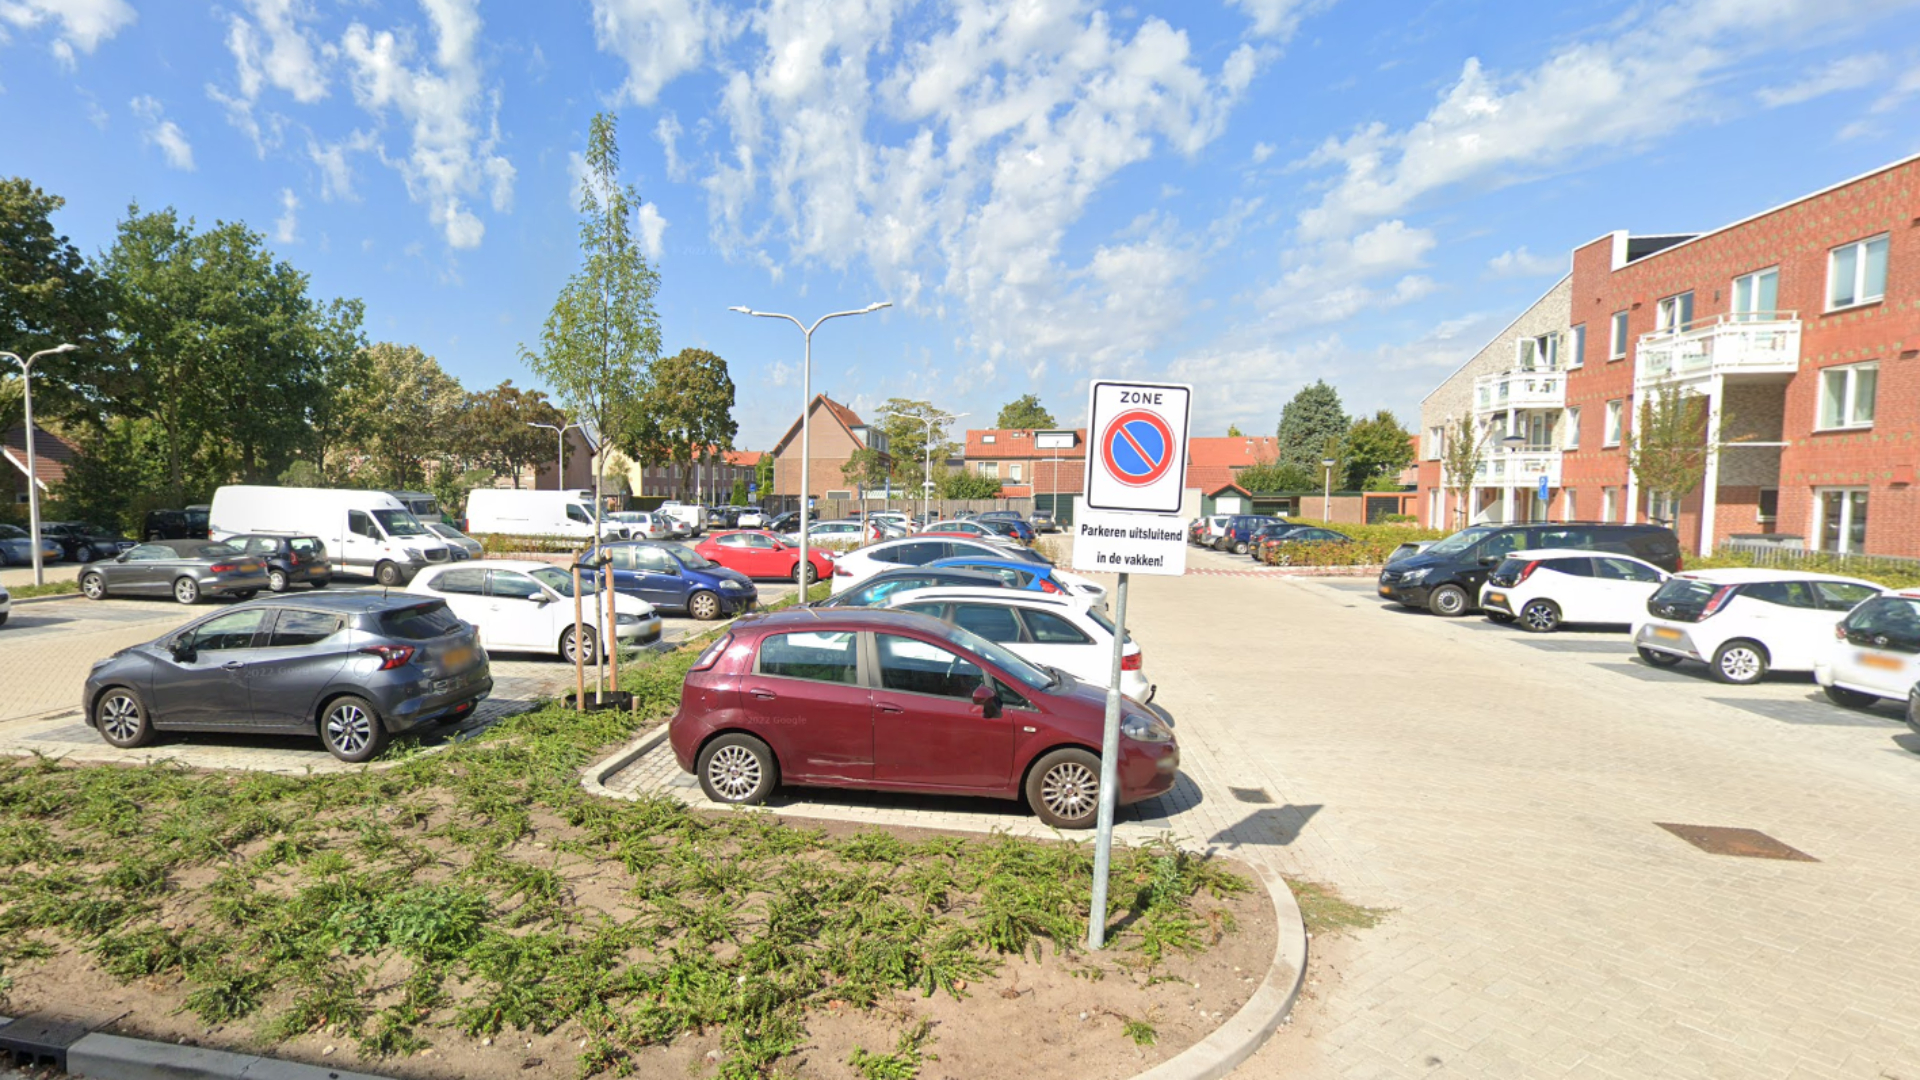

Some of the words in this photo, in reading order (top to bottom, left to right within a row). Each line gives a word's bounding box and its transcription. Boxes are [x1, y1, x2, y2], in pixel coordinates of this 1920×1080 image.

[1120, 391, 1163, 405] ZONE
[1081, 524, 1127, 539] Parkeren
[1129, 526, 1183, 542] uitsluitend
[1097, 551, 1107, 564] in
[1109, 552, 1122, 565] de
[1124, 553, 1164, 568] vakken!
